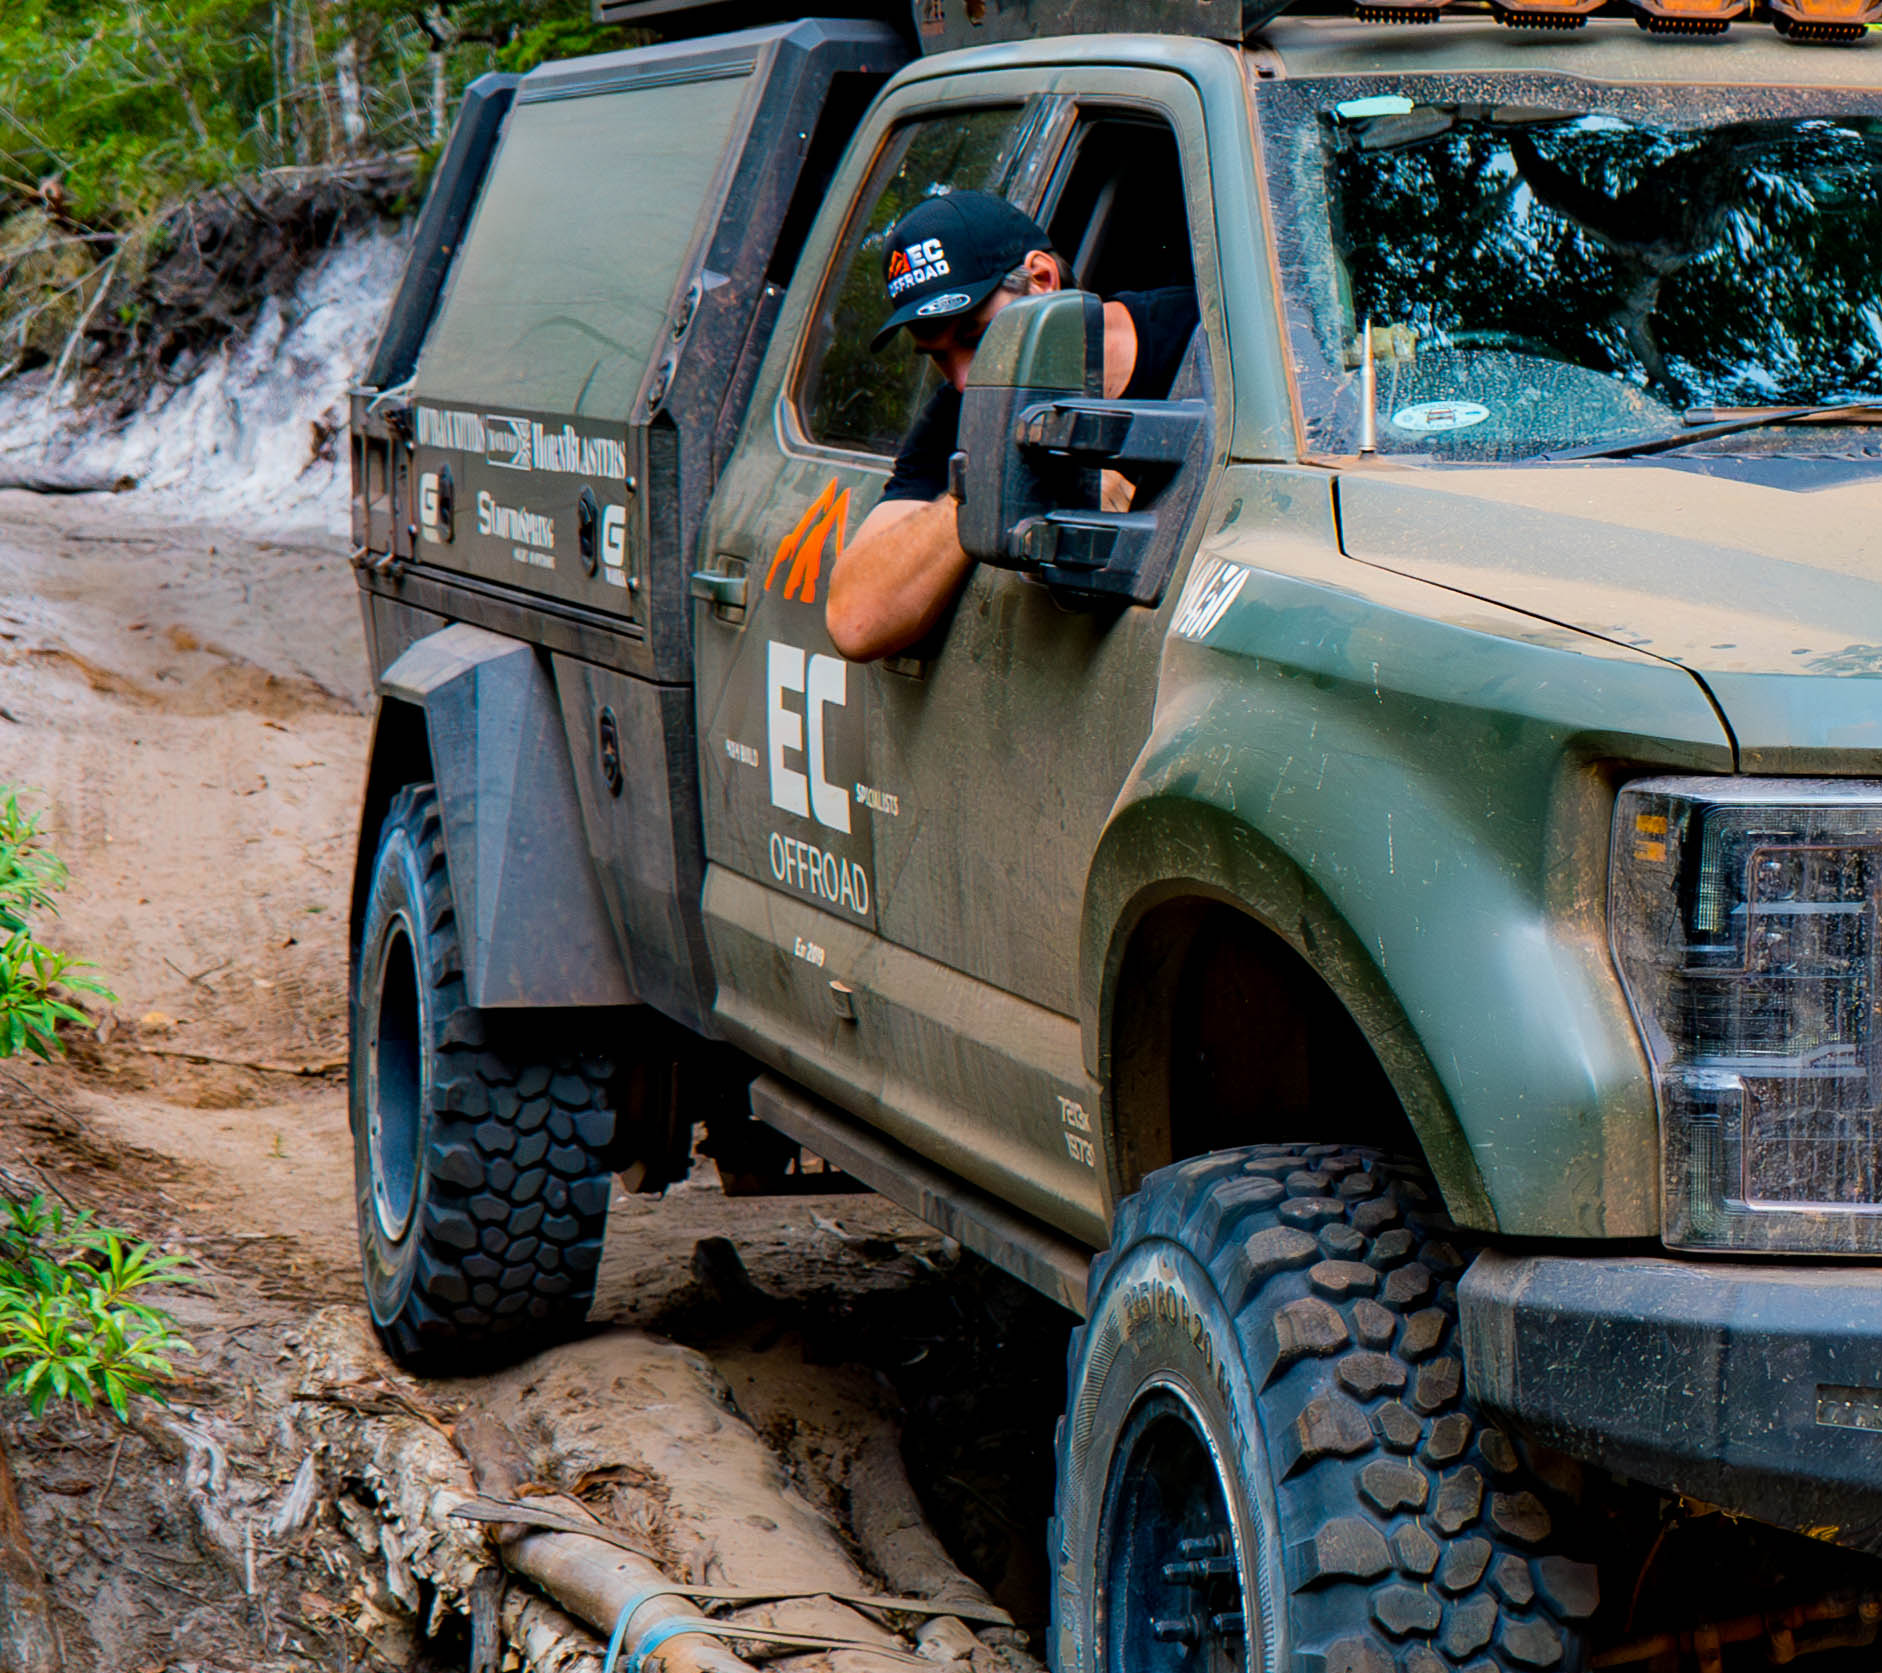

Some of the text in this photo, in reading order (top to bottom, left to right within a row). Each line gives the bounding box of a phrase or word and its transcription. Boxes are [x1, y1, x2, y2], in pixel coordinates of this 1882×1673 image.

[888, 259, 951, 299] OFFROAD
[905, 237, 944, 269] EC
[767, 639, 851, 834] EC
[768, 831, 869, 915] OFFROAD
